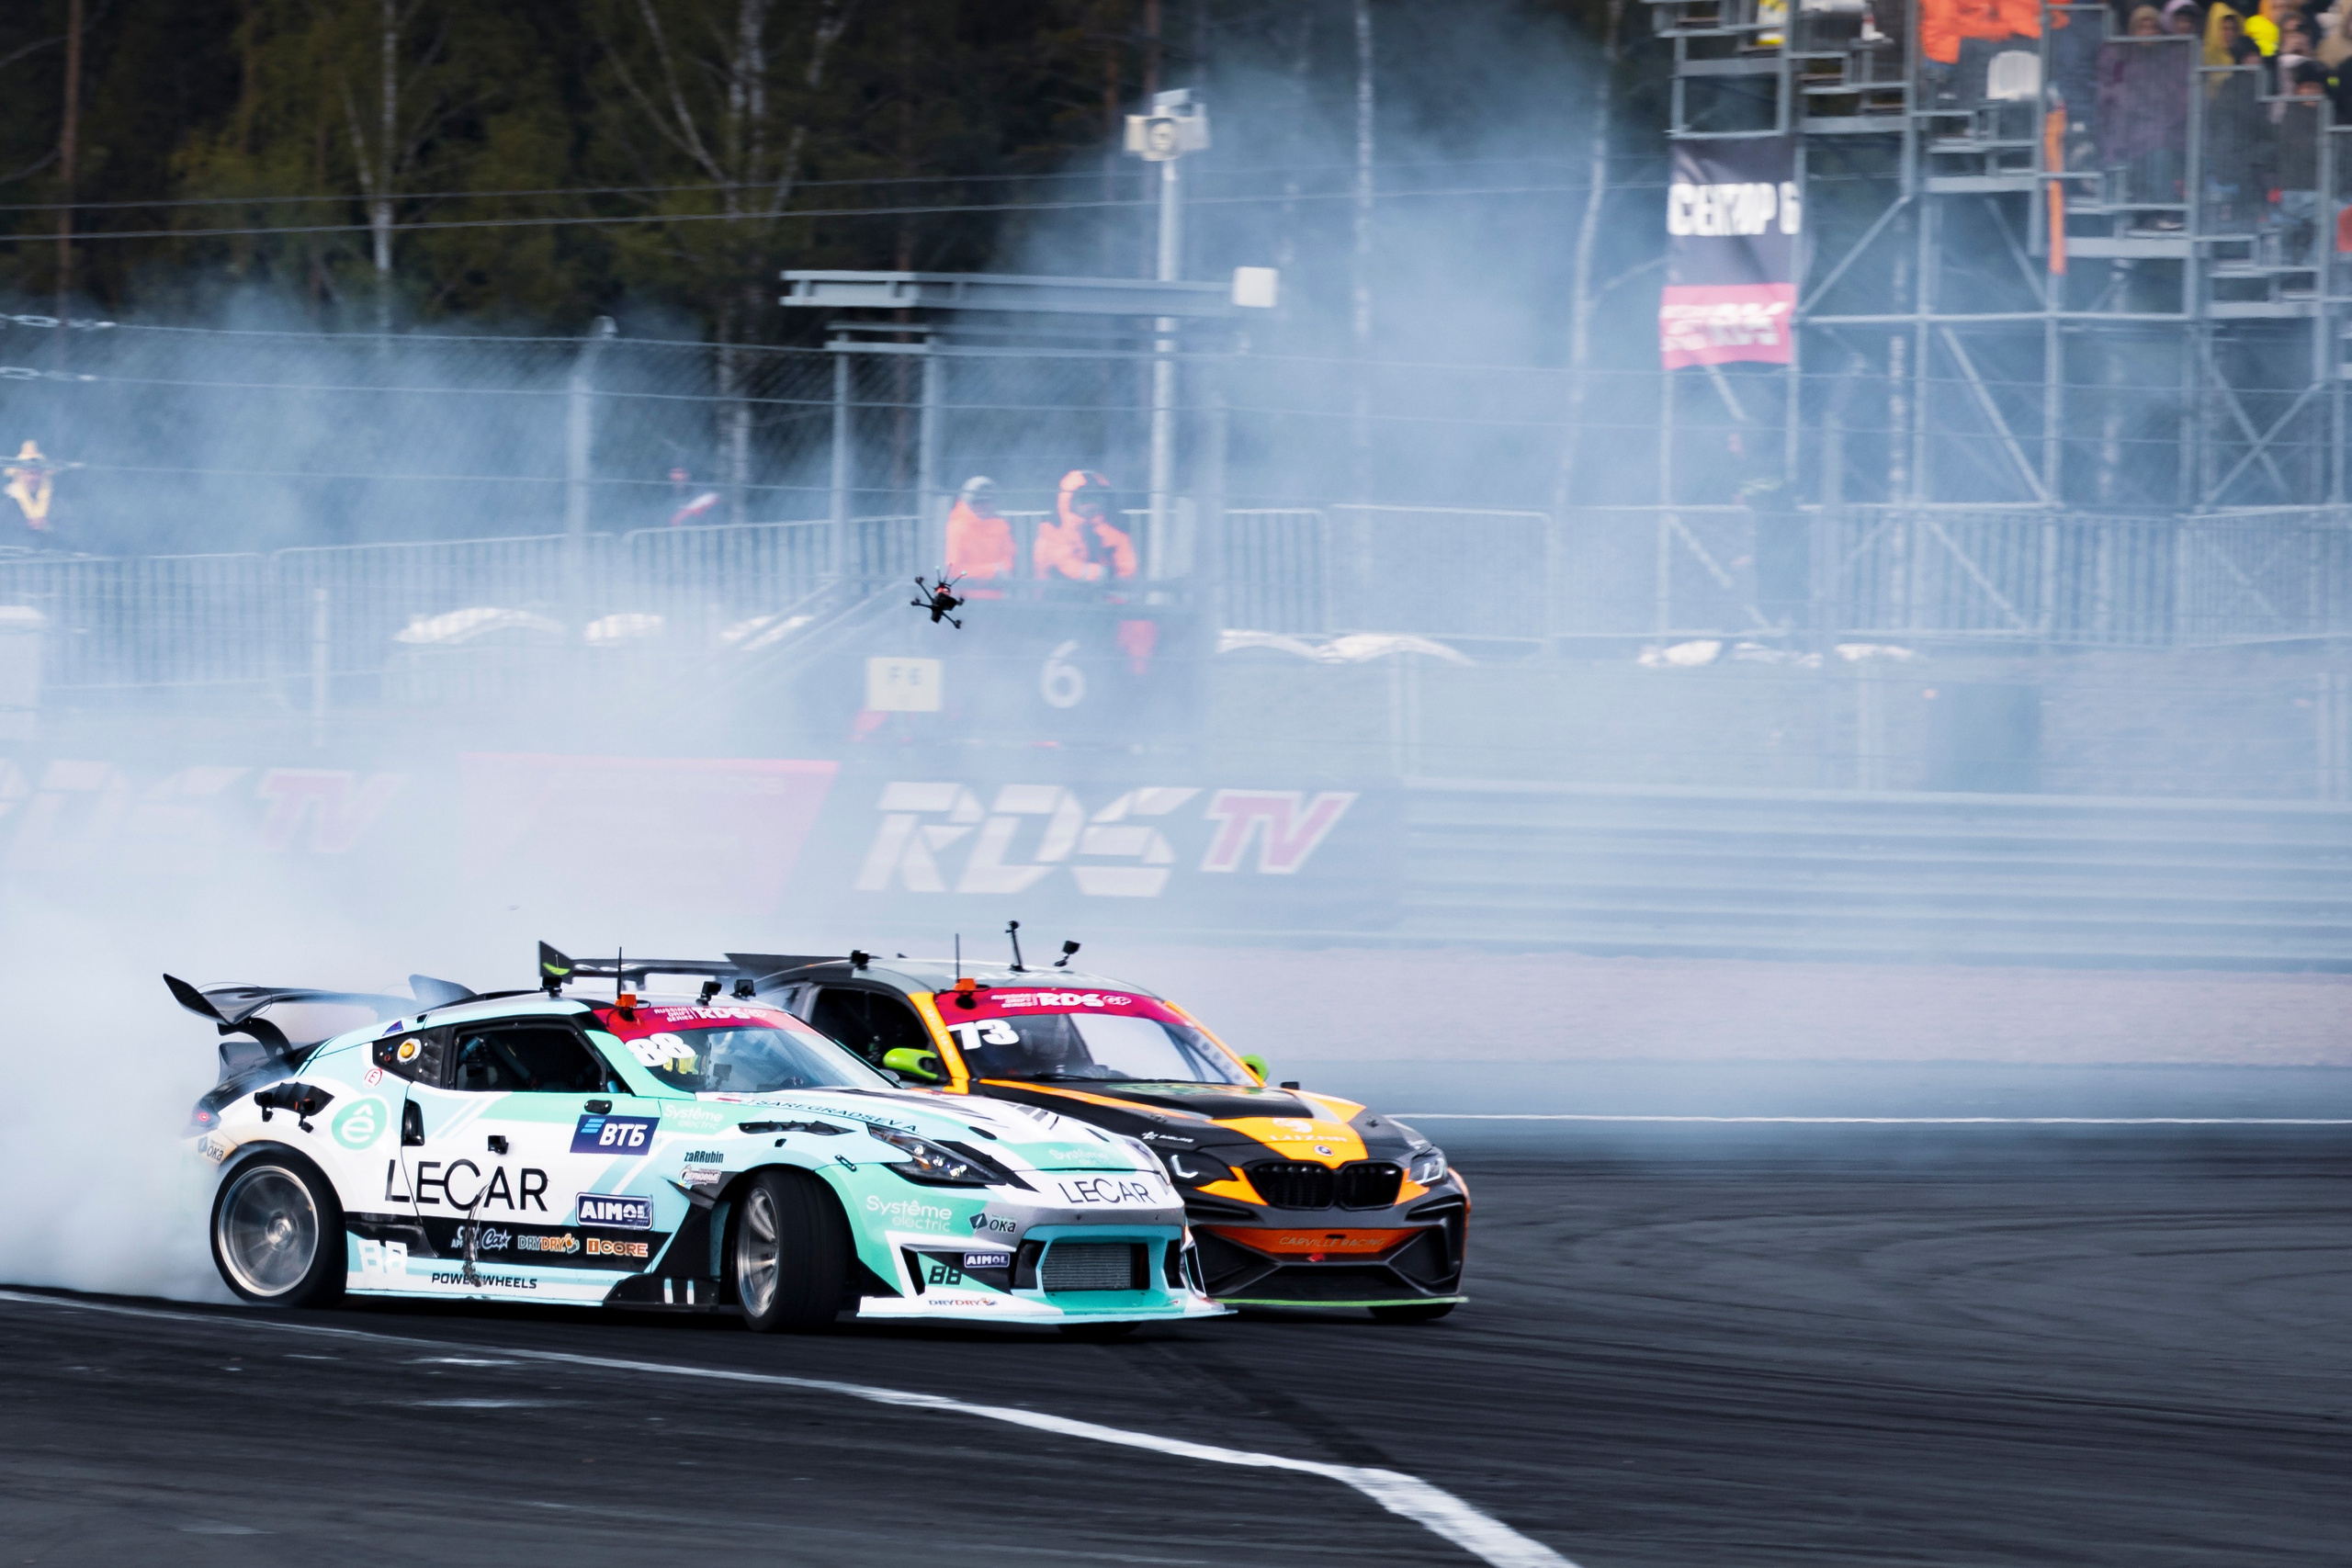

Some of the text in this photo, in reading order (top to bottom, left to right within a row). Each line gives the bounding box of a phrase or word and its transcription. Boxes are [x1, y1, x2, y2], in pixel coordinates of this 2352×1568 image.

[1041, 640, 1087, 708] 6
[854, 782, 1361, 897] RDS TV
[1036, 992, 1104, 1008] RDS
[693, 1007, 752, 1020] RDS
[945, 1019, 1020, 1050] 73
[625, 1032, 696, 1066] 88
[599, 1123, 649, 1147] ВТБ
[684, 1150, 725, 1164] zaRRubin
[384, 1158, 548, 1212] LECAR
[1057, 1178, 1157, 1204] LECAR
[580, 1201, 650, 1223] AIMOL
[891, 1214, 951, 1233] electric
[966, 1255, 1008, 1266] AIMOL
[928, 1265, 962, 1285] 88
